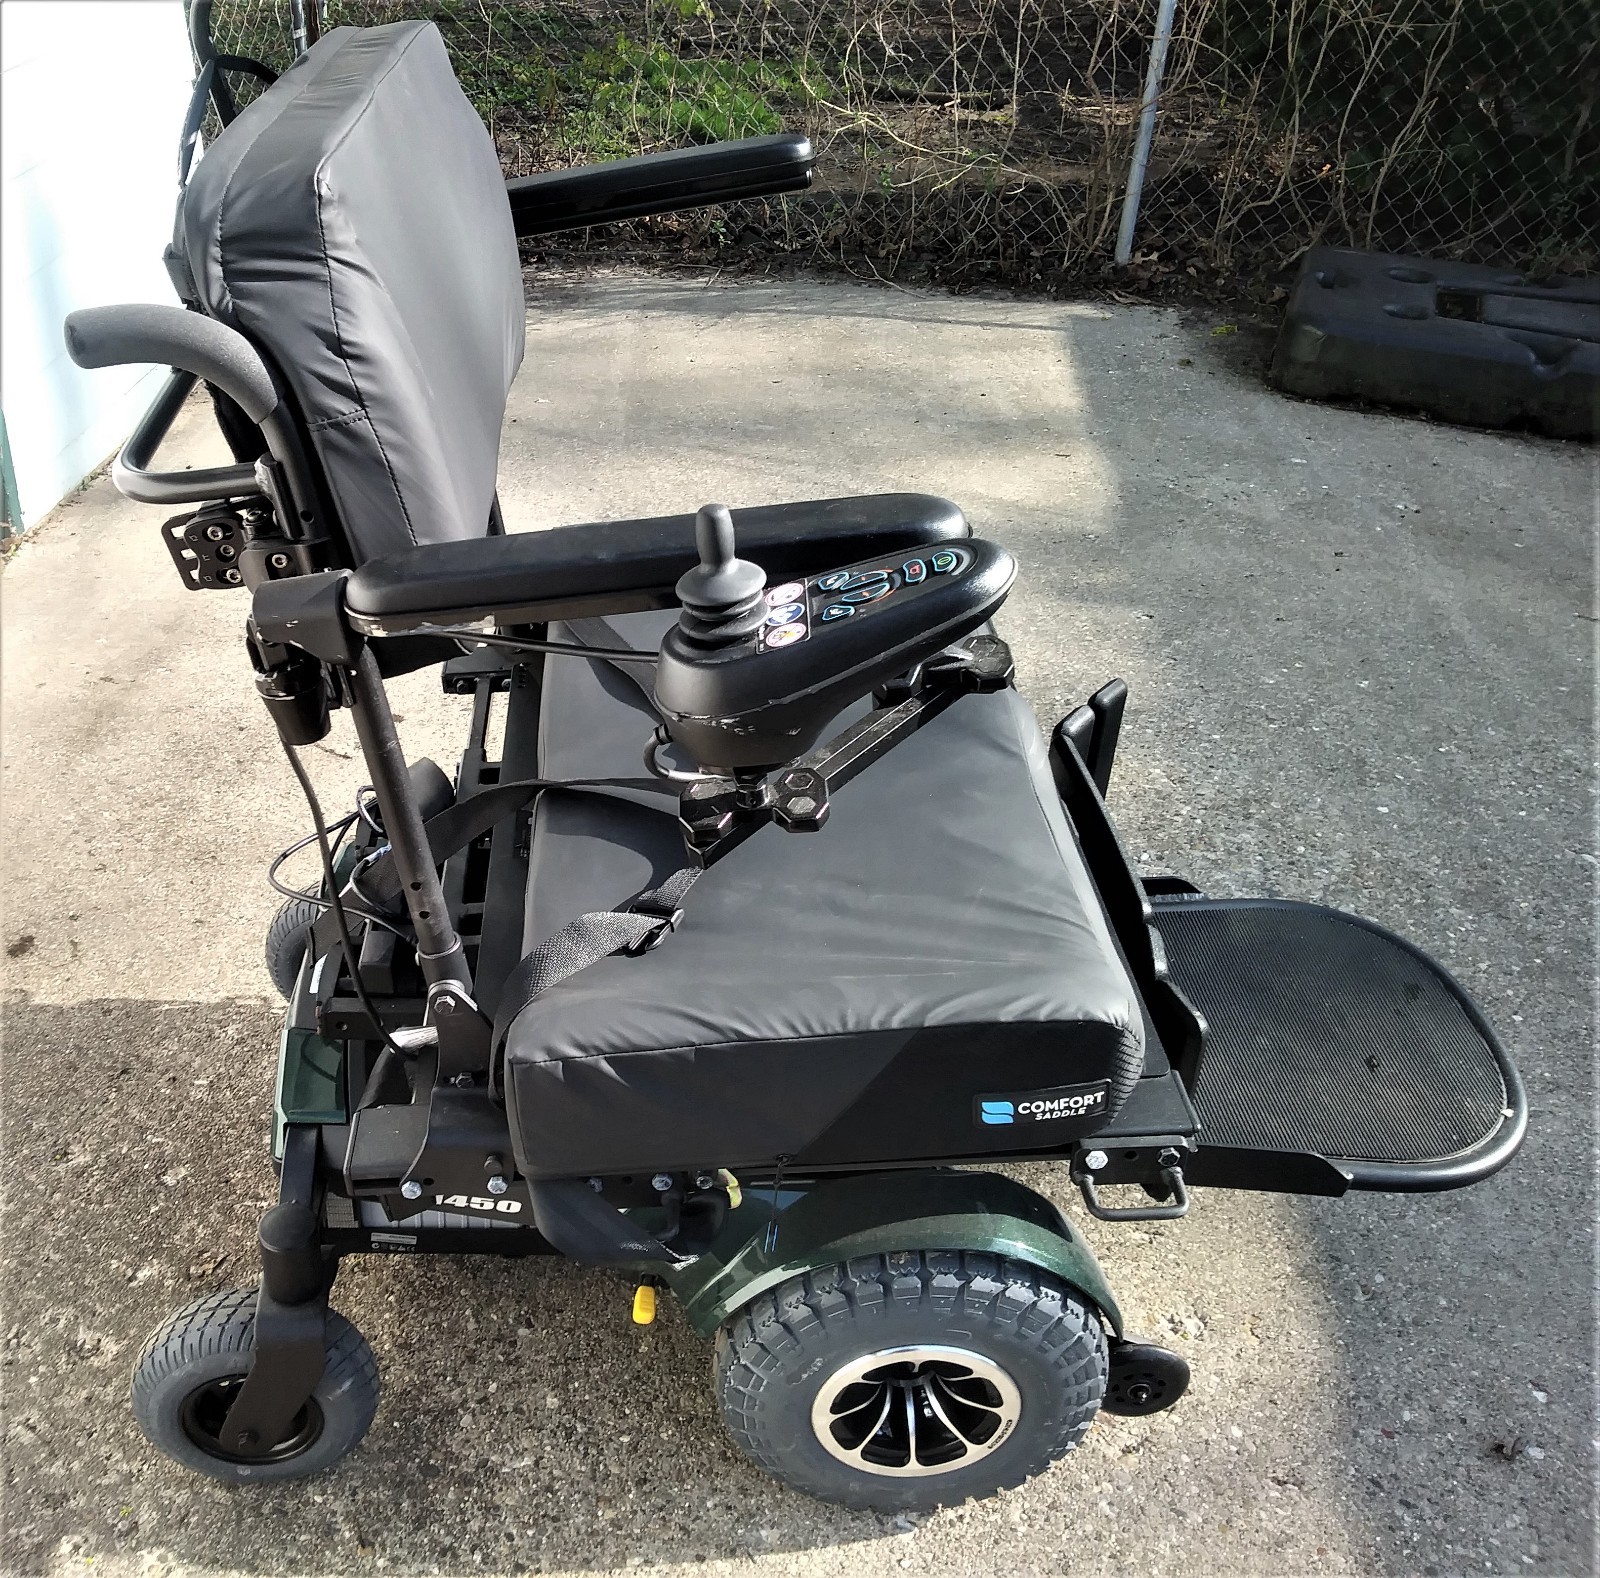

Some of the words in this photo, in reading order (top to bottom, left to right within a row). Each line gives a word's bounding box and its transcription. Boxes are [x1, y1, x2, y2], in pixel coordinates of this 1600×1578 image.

[1018, 1091, 1105, 1115] COMFORT
[1035, 1107, 1087, 1121] SADDLE
[435, 1194, 523, 1214] 1450
